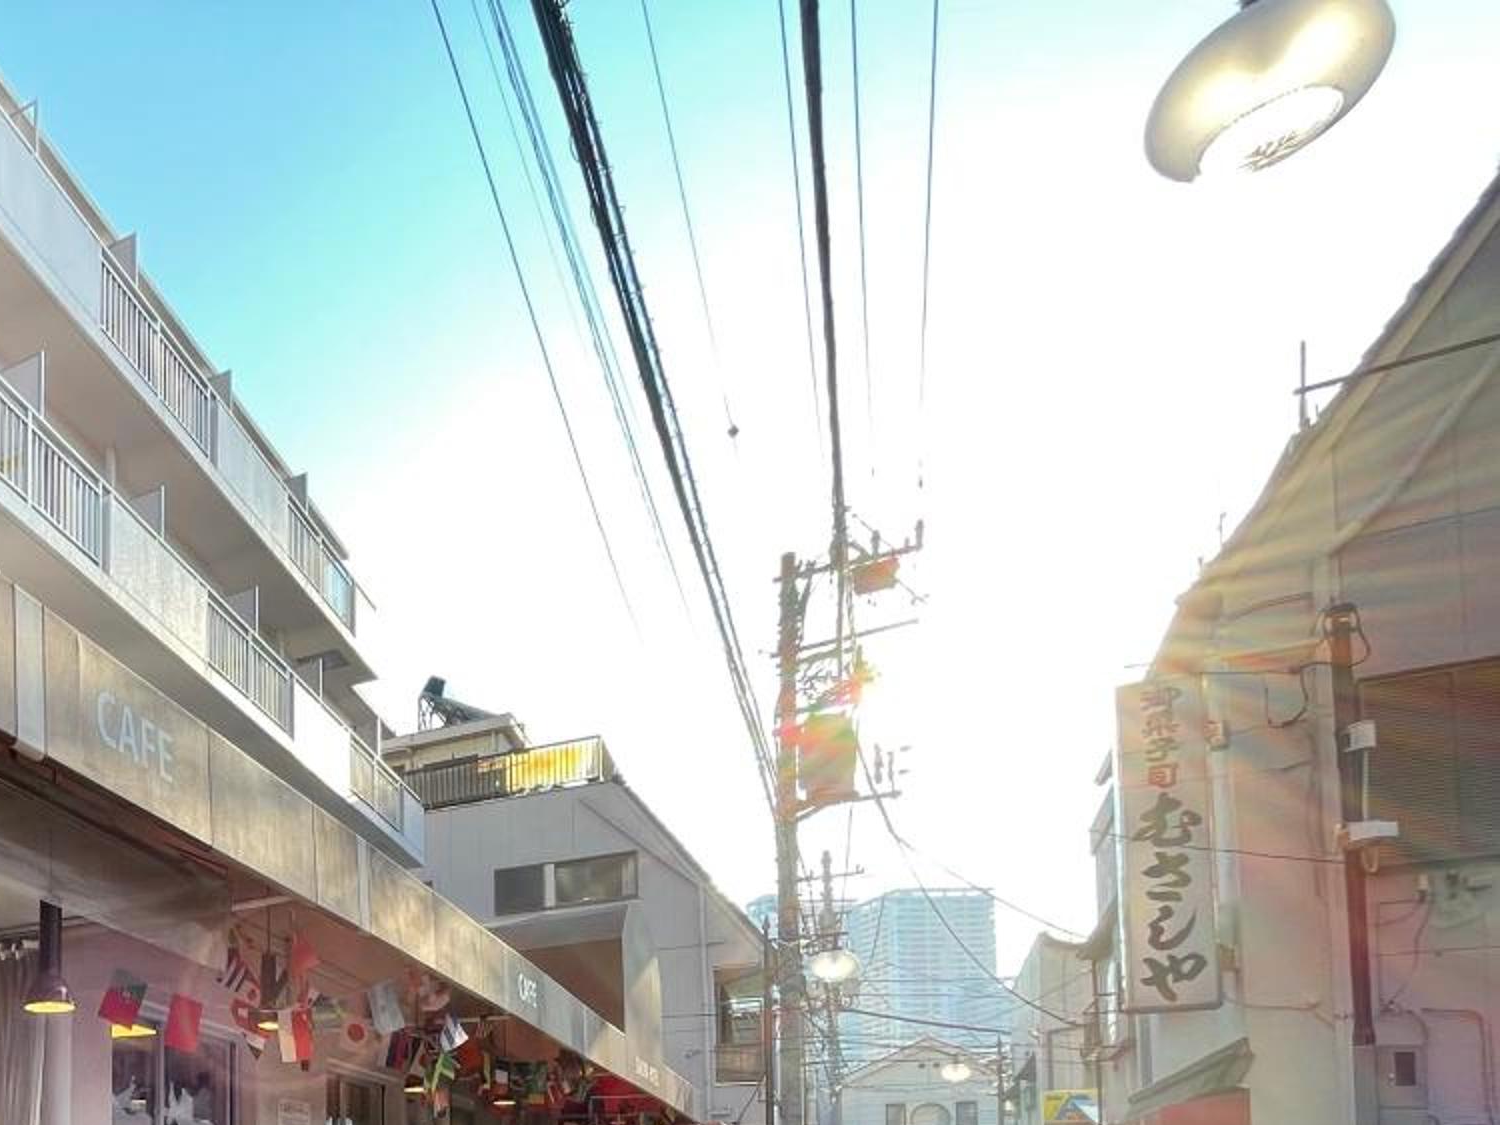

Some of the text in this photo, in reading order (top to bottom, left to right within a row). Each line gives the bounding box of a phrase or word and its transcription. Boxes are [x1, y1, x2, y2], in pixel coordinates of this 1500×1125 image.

[97, 691, 174, 784] CAFE
[1132, 792, 1207, 1002] むさしや
